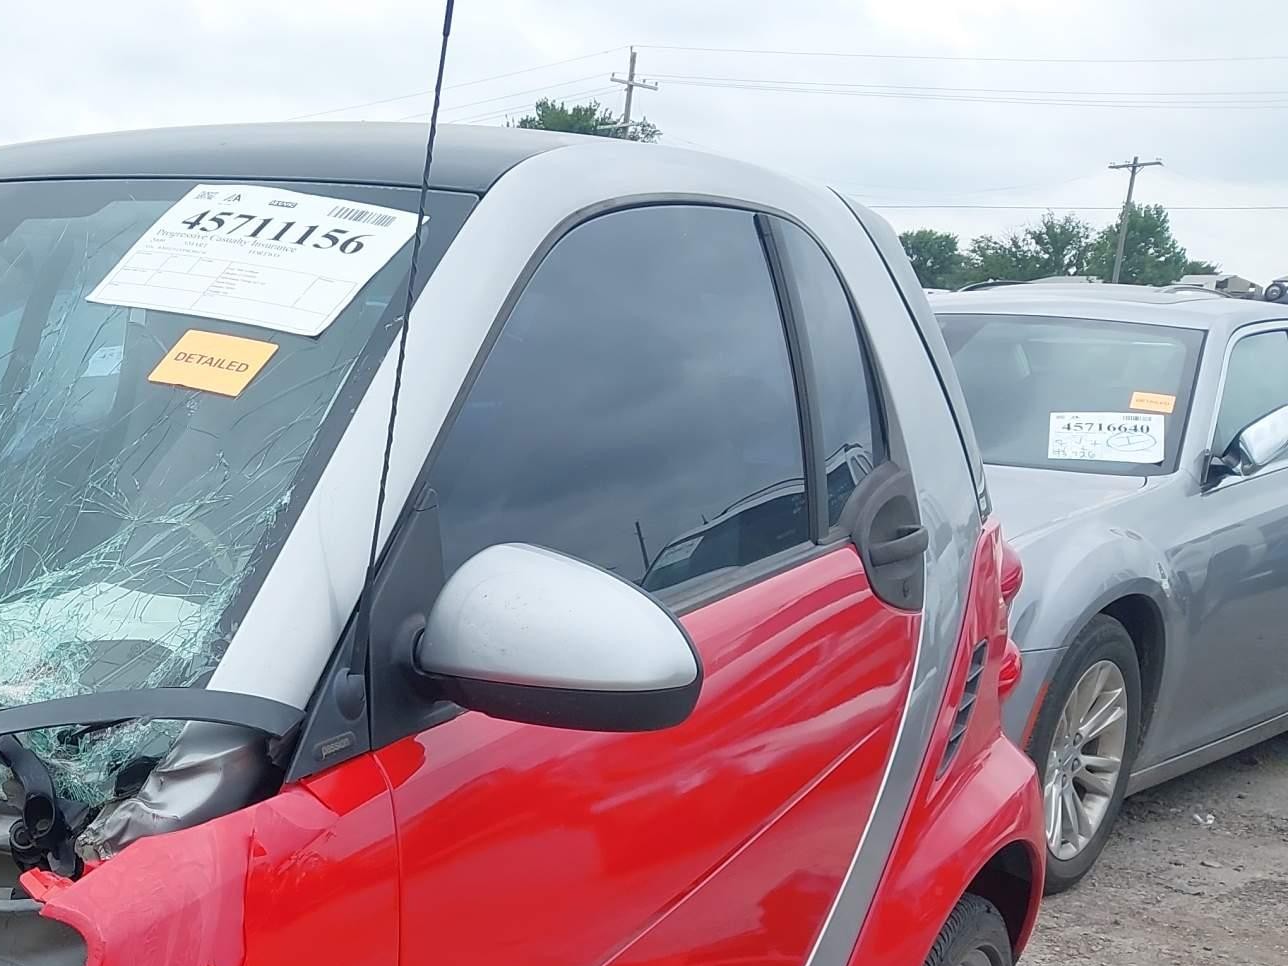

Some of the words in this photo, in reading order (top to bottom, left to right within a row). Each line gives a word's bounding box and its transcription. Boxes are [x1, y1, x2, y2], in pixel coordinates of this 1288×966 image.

[156, 228, 208, 241] Progressive
[209, 234, 250, 248] Casualty
[250, 239, 298, 254] Insurance
[181, 210, 376, 254] 45711156
[174, 351, 249, 373] DETAILED
[1061, 422, 1151, 434] 45716640
